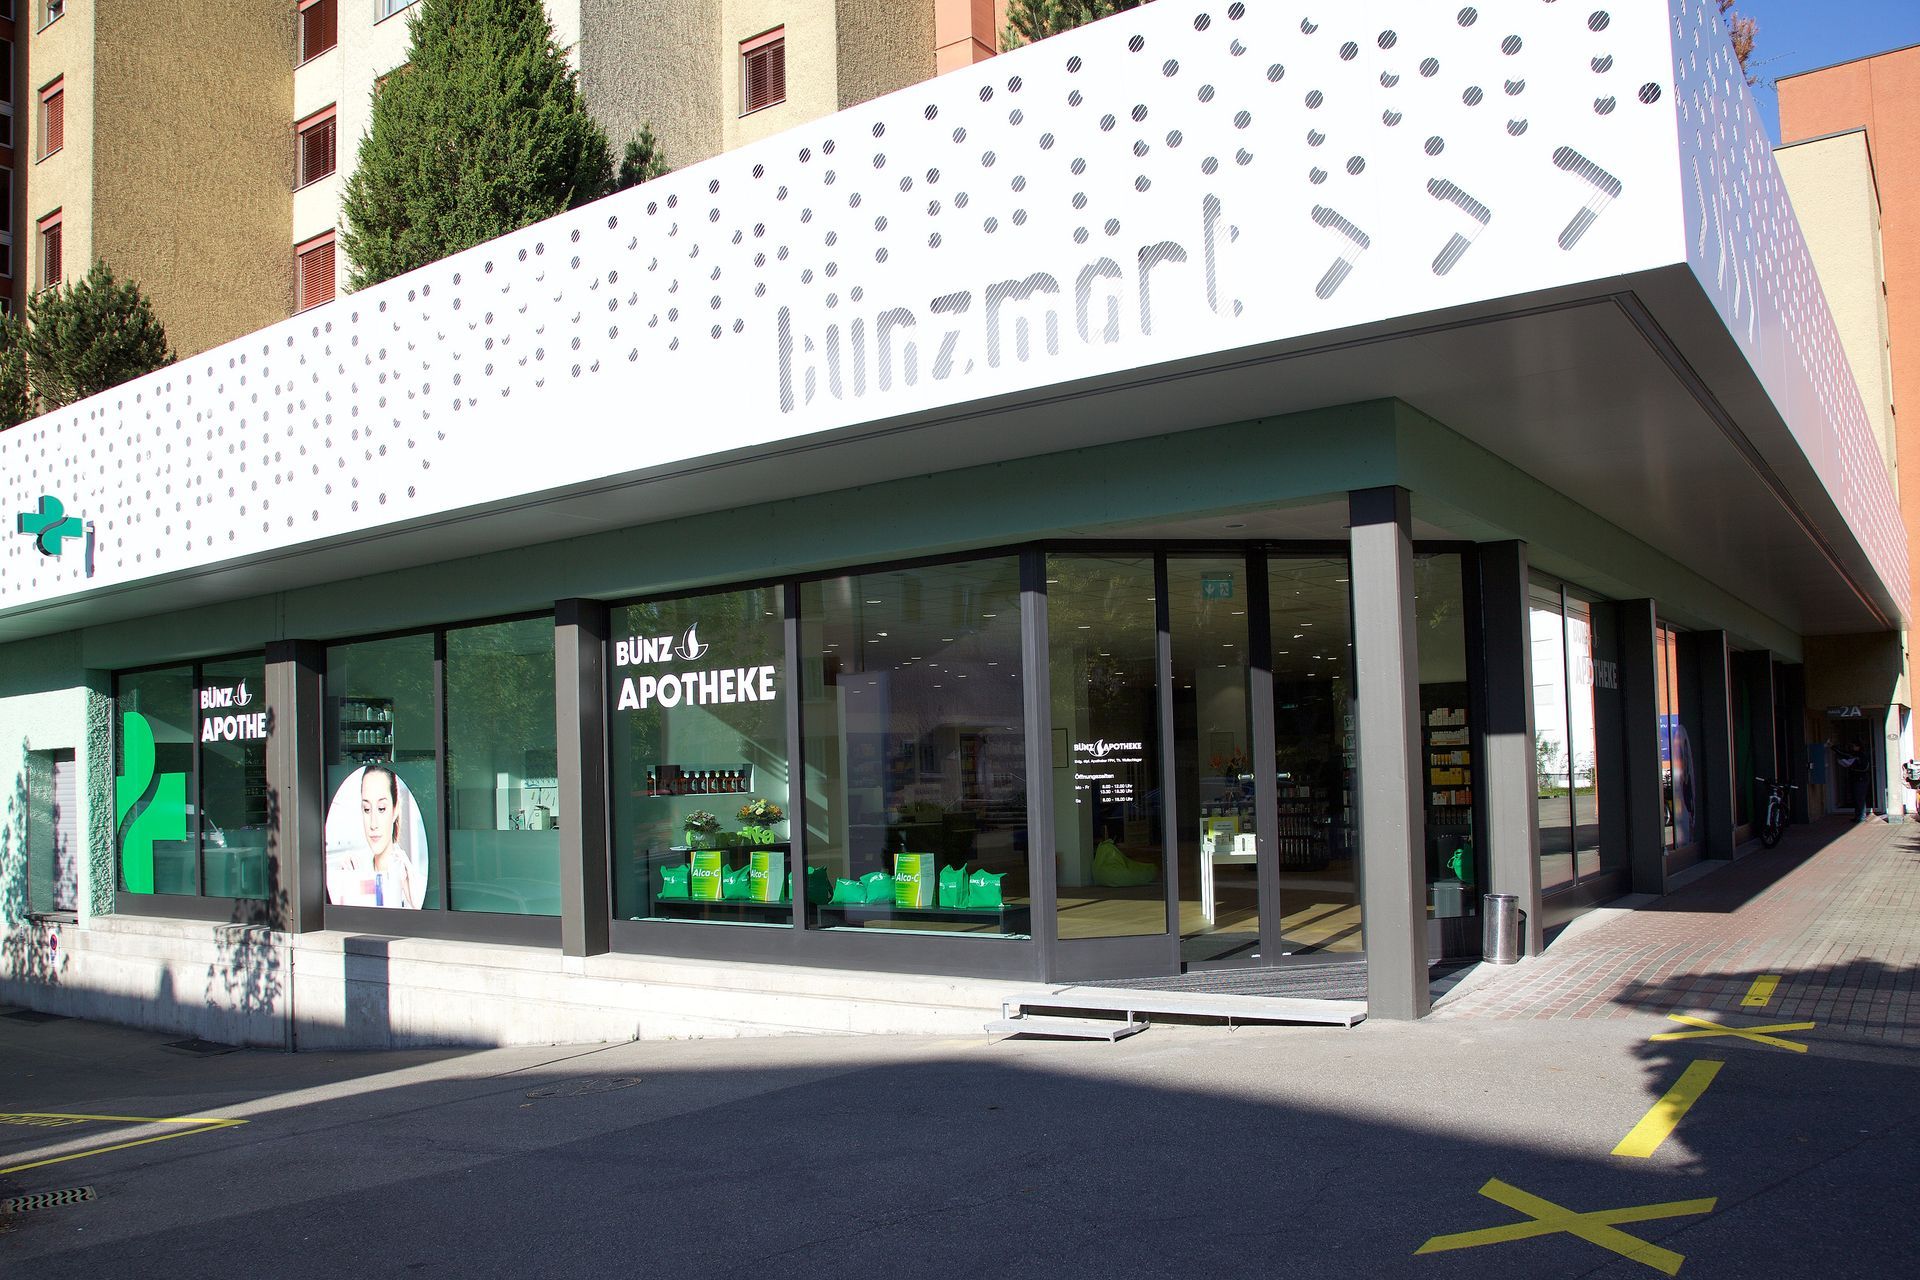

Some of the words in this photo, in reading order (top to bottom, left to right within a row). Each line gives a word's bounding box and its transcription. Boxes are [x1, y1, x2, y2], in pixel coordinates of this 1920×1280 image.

[616, 635, 674, 666] BÜNZ
[201, 686, 233, 709] BÜNZ
[617, 665, 776, 711] APOTHEKE
[1840, 705, 1862, 717] 2A
[1103, 742, 1142, 752] APOTHEKE
